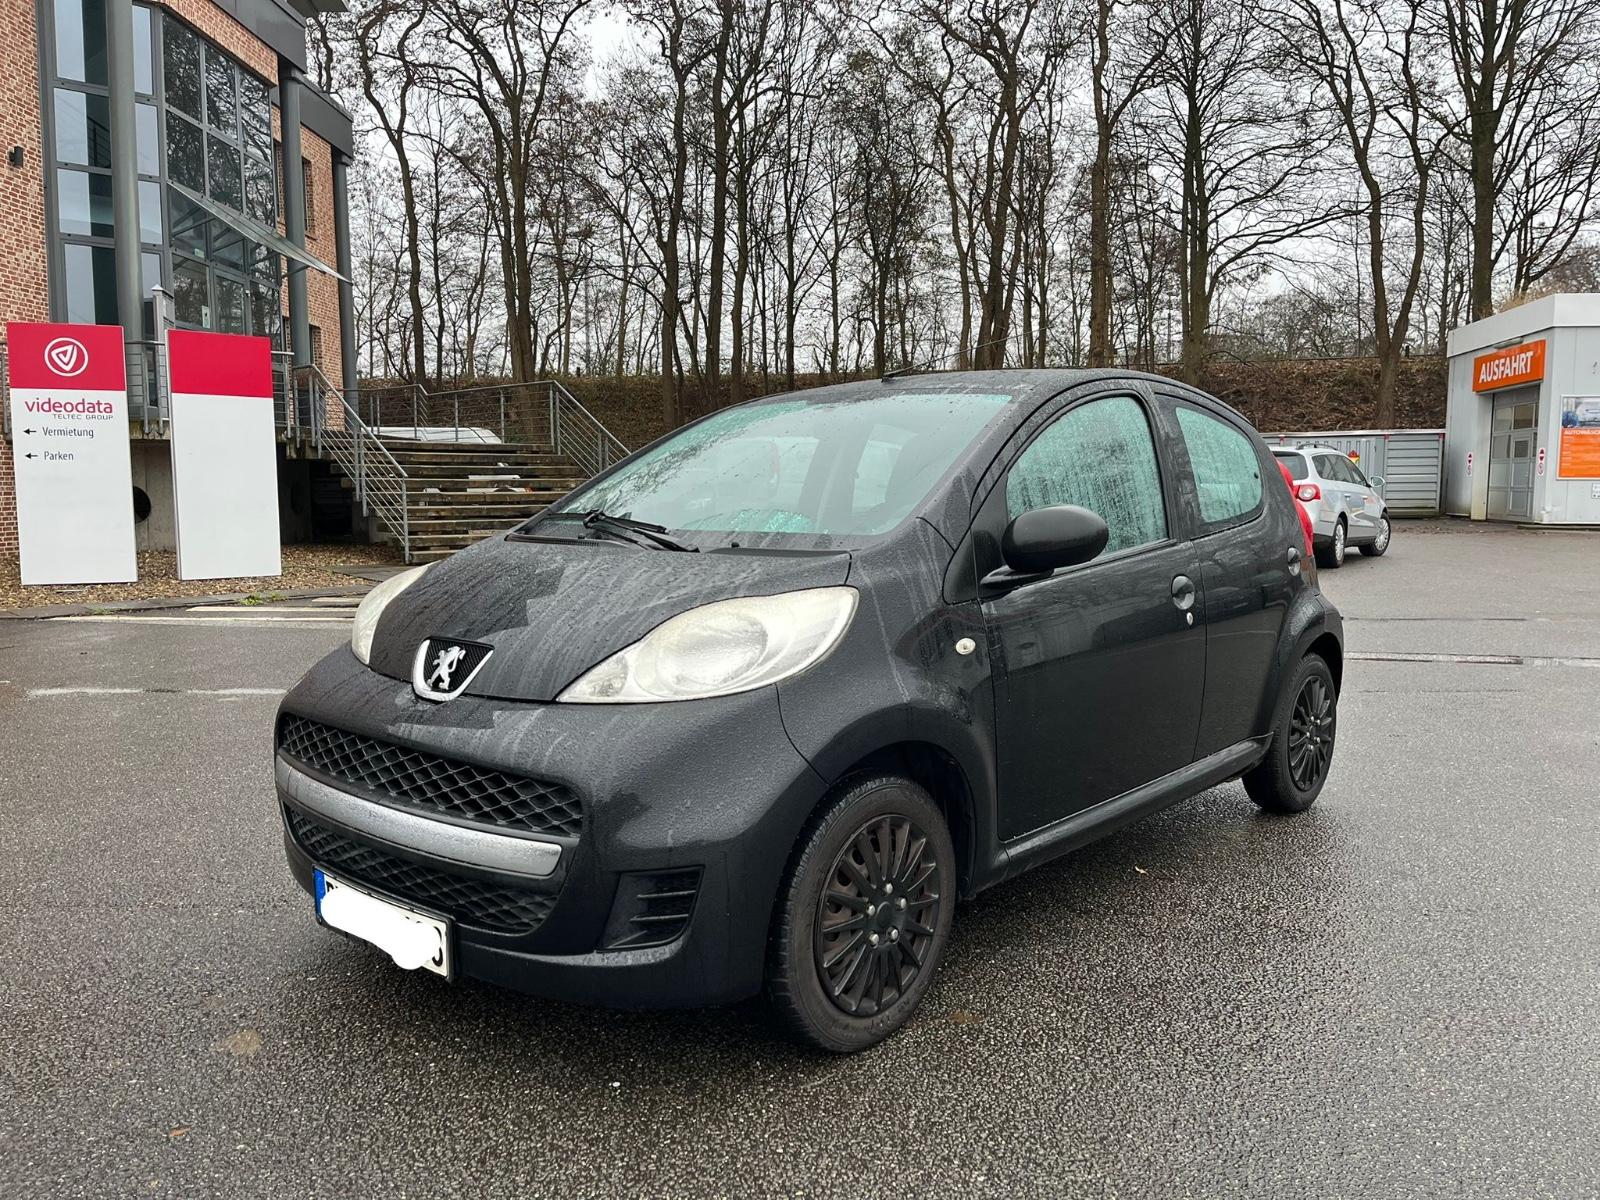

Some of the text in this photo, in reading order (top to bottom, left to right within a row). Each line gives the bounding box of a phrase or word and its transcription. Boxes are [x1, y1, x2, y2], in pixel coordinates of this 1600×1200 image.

[1478, 351, 1534, 384] AUSFAHRT
[24, 397, 114, 414] videodata
[42, 427, 94, 439] Vermietung
[44, 451, 75, 461] Parken
